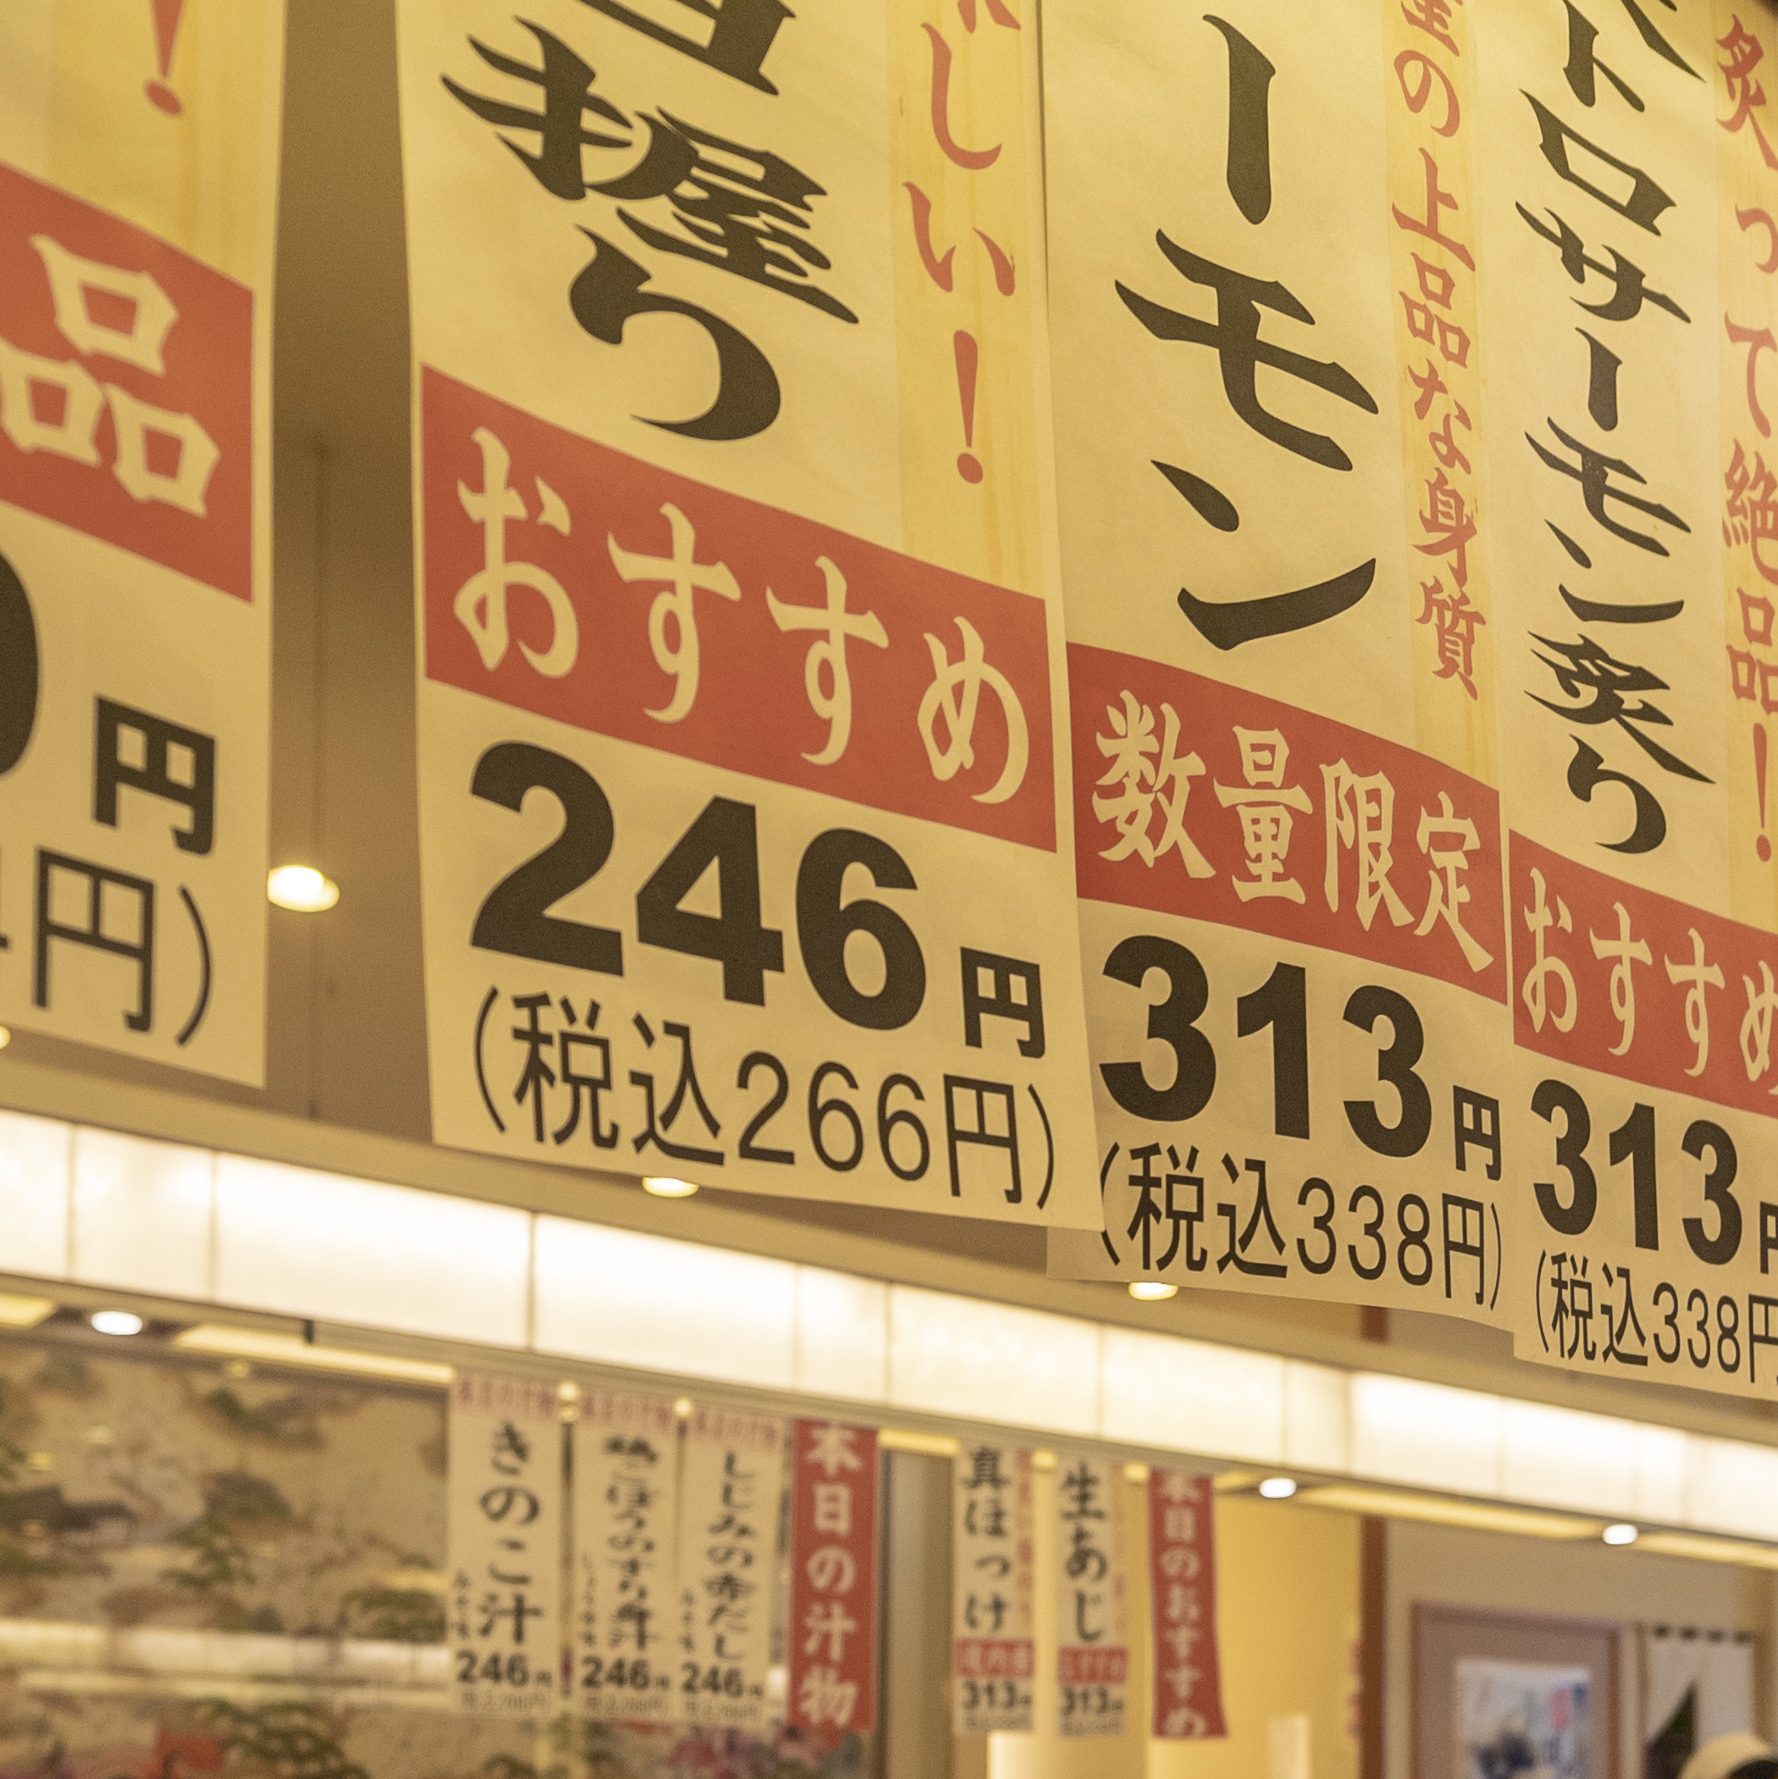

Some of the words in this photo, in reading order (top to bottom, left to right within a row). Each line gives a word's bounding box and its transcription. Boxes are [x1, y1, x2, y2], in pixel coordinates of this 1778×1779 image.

[439, 0, 860, 441] 握り
[902, 0, 1021, 484] しい!
[1514, 0, 1716, 855] トロサーモン炙り
[455, 426, 1029, 805] おすすめ
[469, 739, 1047, 1061] 246円
[1092, 688, 1494, 974] 数量限定
[474, 984, 1054, 1210] (税込266円)
[1099, 935, 1502, 1183] 313円
[1097, 1140, 1502, 1312] (税込338円)
[478, 1420, 545, 1645] きのこ汁
[797, 1424, 864, 1728] 本日の汁物
[962, 1446, 1012, 1636] 真ほっけ
[1061, 1460, 1109, 1642] 生あじ
[1160, 1470, 1210, 1738] 本日のおすすめ
